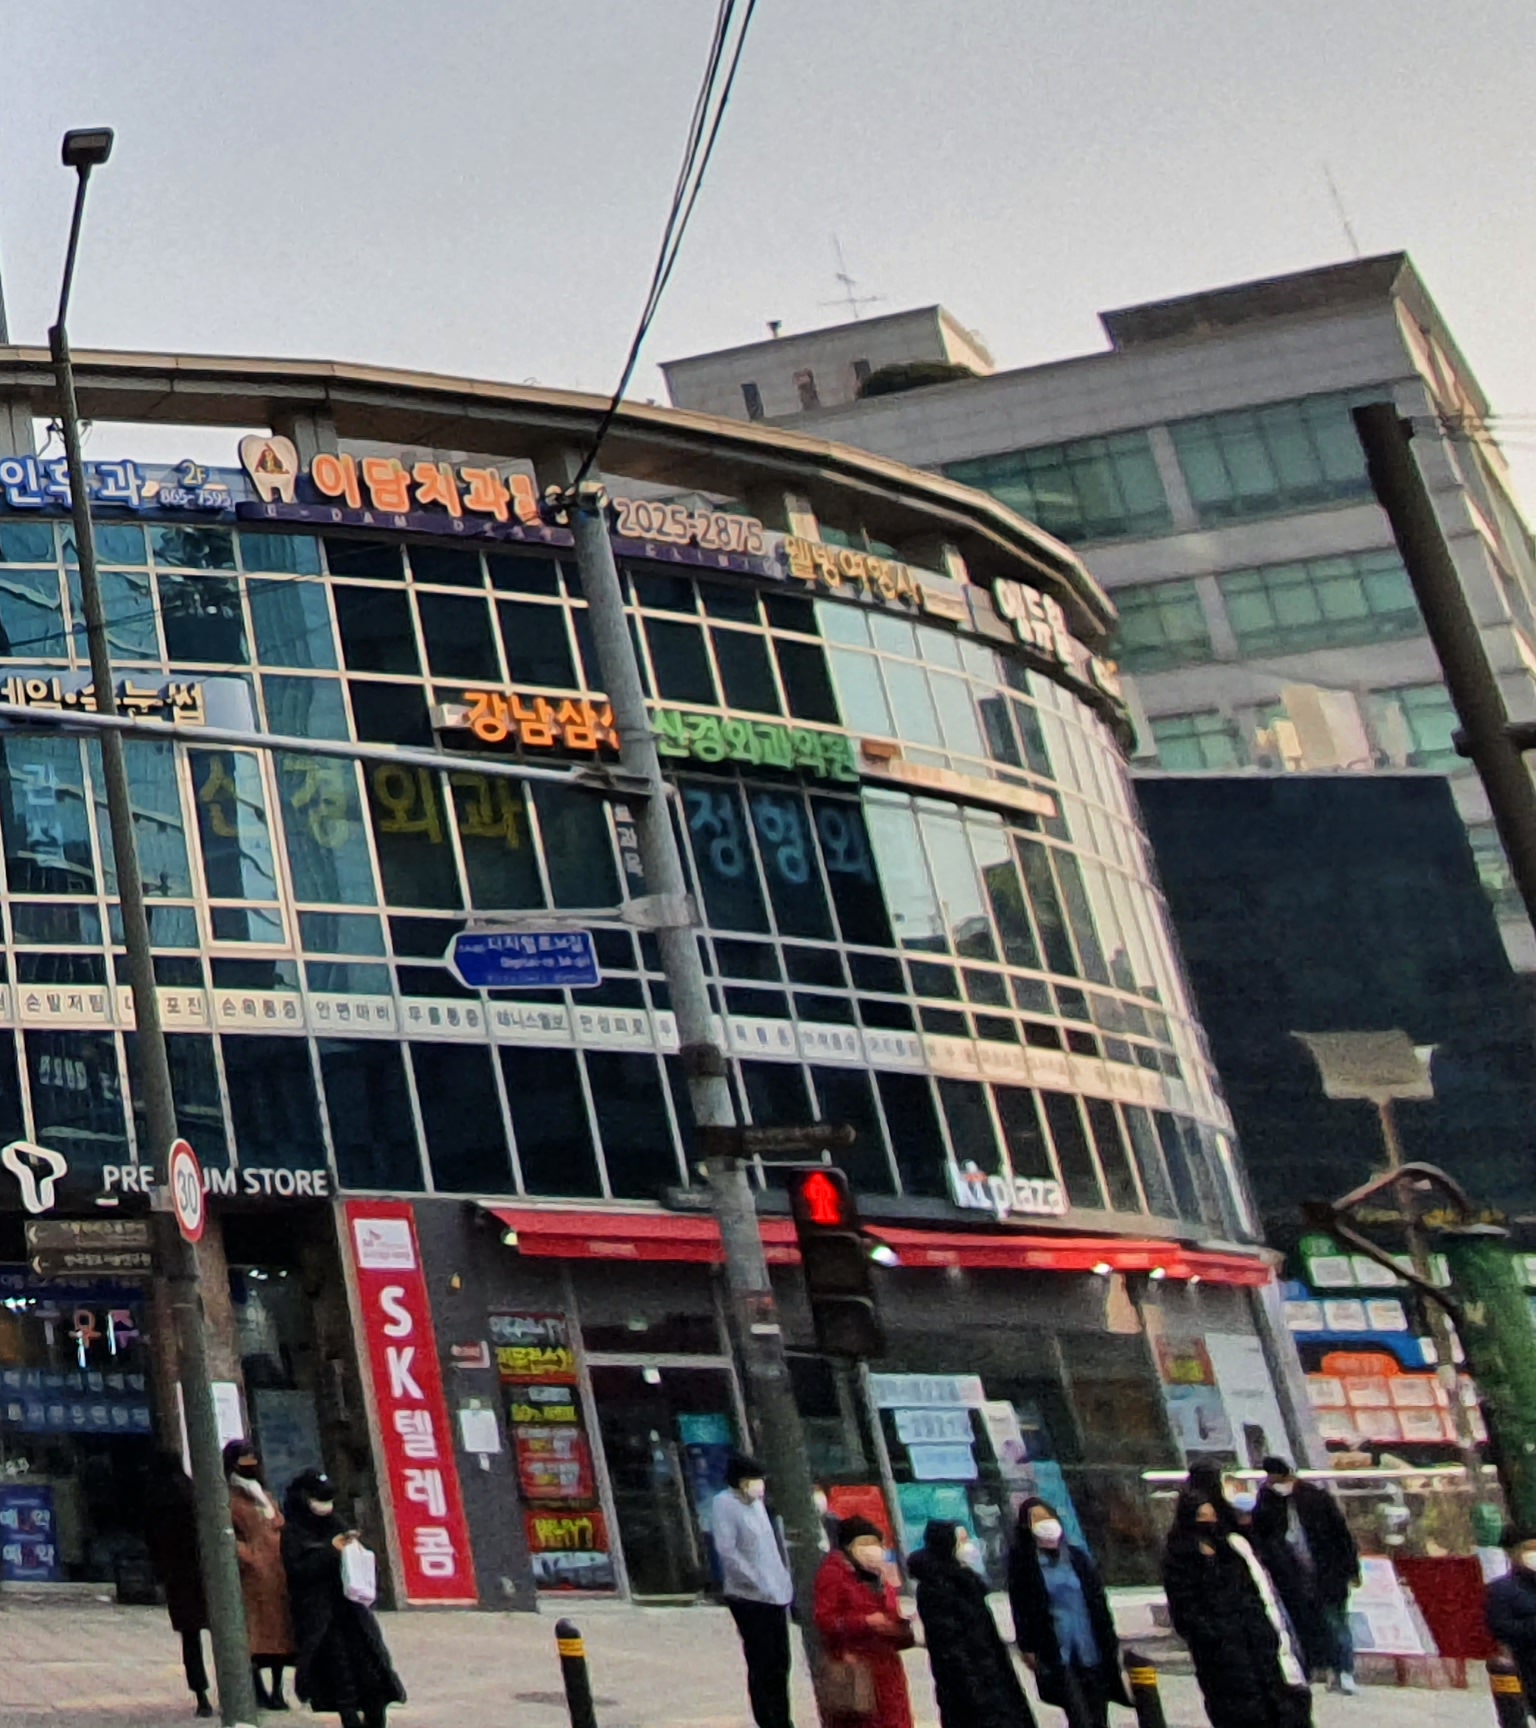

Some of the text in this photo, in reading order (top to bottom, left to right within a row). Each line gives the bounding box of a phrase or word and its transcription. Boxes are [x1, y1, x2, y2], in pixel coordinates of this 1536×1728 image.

[612, 496, 766, 556] 2025-2875
[25, 992, 106, 1016] 손발저림
[220, 997, 299, 1020] 손목통증
[314, 998, 391, 1023] 안면마비
[102, 1163, 328, 1197] PREUM STORE
[177, 1175, 199, 1212] 30
[378, 1284, 456, 1578] SK텔레콤
